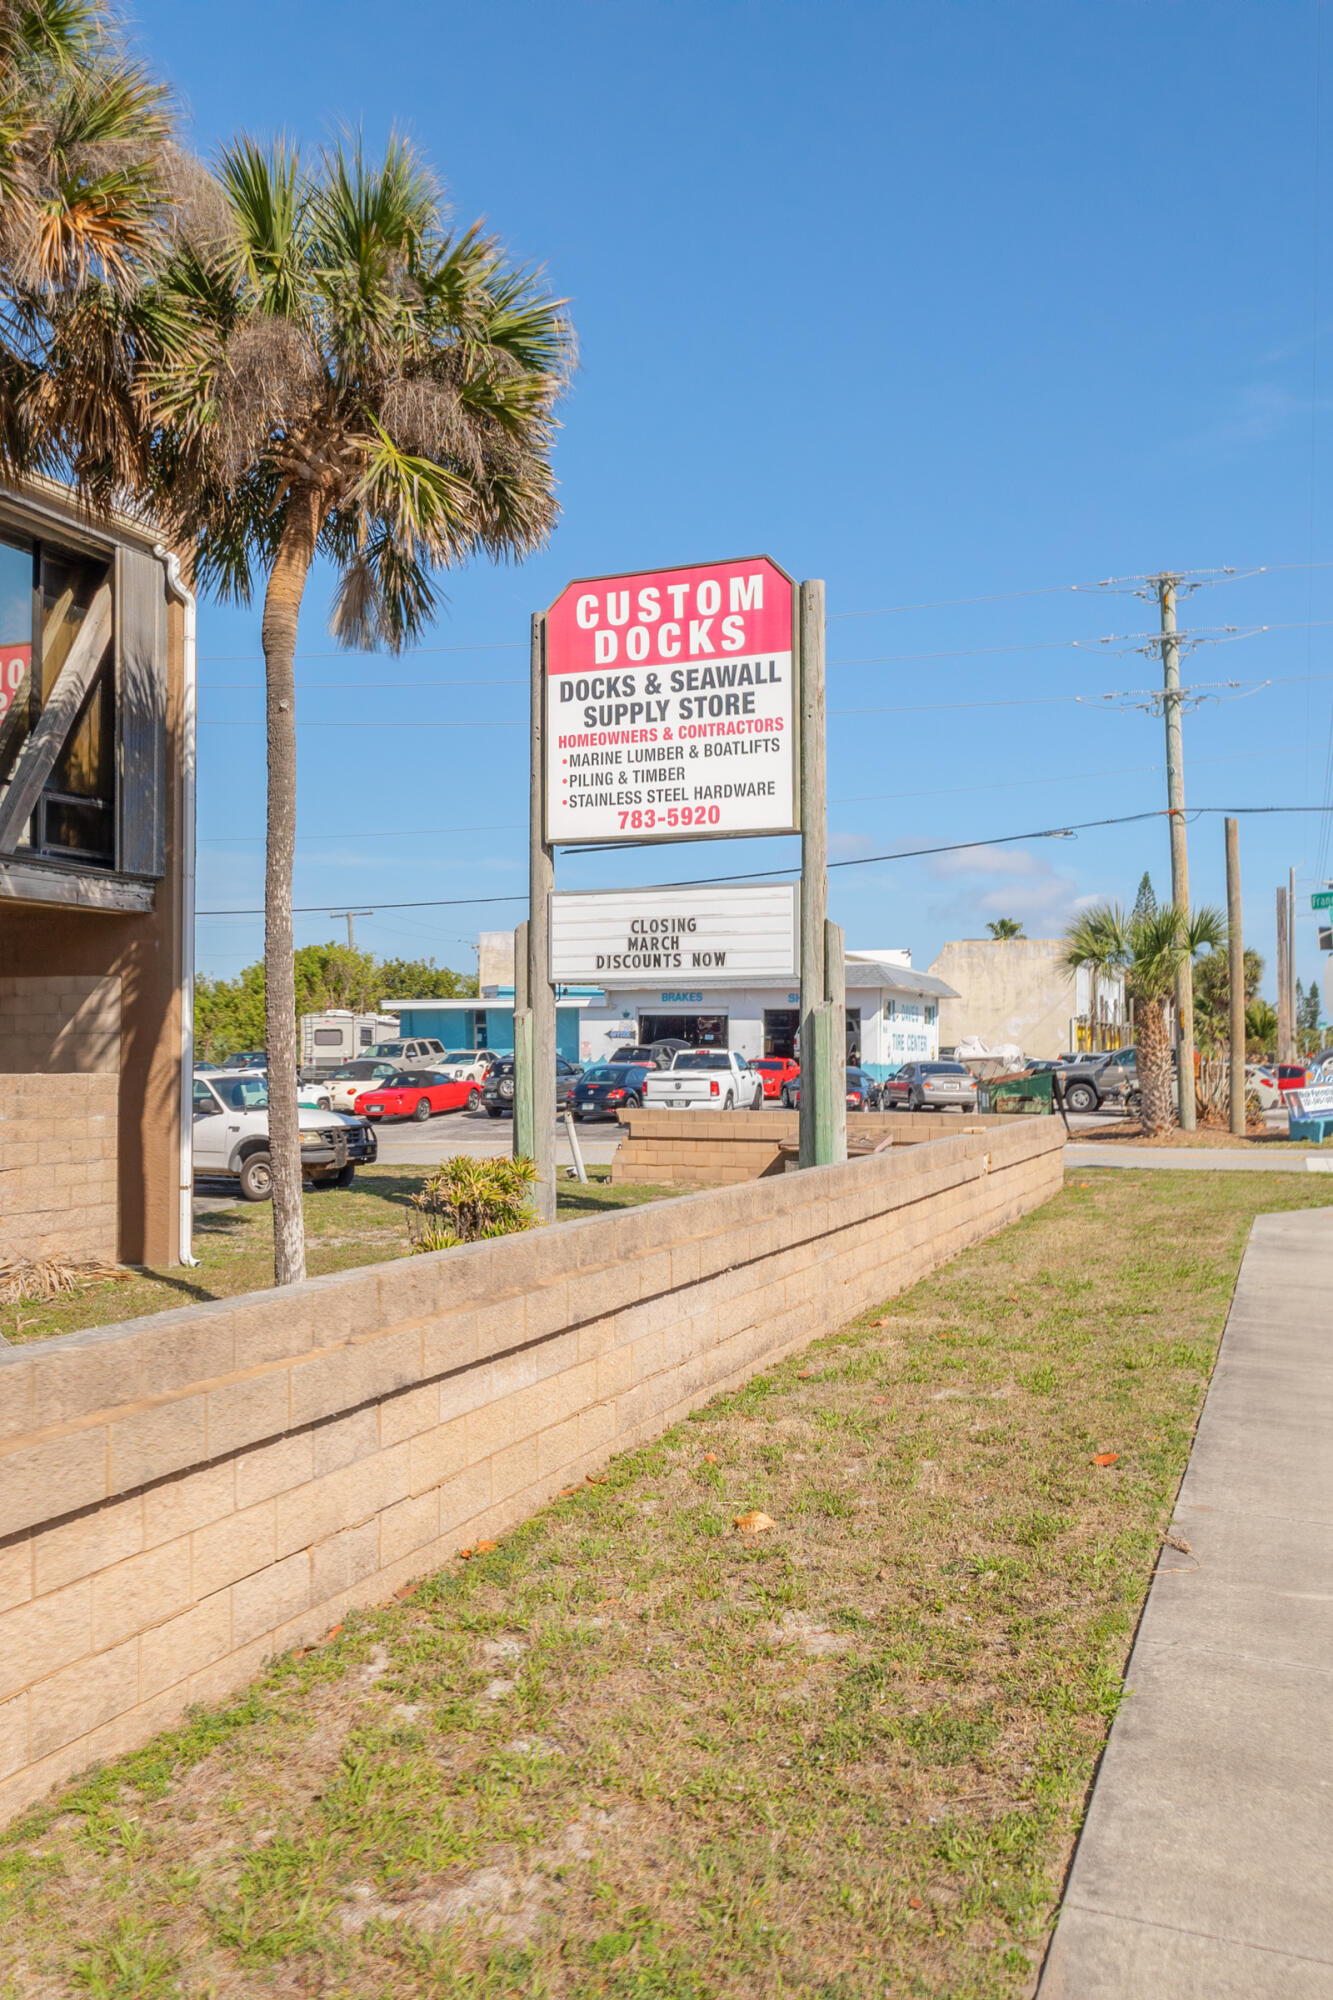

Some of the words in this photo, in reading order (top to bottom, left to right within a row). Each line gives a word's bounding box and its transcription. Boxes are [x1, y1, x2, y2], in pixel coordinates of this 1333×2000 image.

[576, 573, 764, 629] CUSTOM
[594, 614, 746, 664] DOCKS
[559, 674, 636, 703] DOCKS
[645, 672, 662, 695] &
[670, 660, 782, 693] SEAWALL
[583, 698, 670, 728] SUPPLY
[679, 691, 756, 720] STORE
[558, 728, 658, 749] HOMEOWNERS
[663, 726, 673, 741] &
[678, 716, 784, 739] CONTRACTORS
[569, 750, 623, 768] MARINE
[627, 746, 684, 764] LUMBER
[689, 744, 699, 759] &
[704, 737, 781, 758] BOATLIFTS
[569, 771, 614, 788] PILING
[618, 770, 628, 785] &
[633, 766, 686, 784] TIMBER
[569, 790, 642, 809] STAINLESS
[647, 785, 689, 804] STEEL
[694, 780, 776, 801] HARDWARE
[617, 805, 721, 830] 783-5920
[631, 918, 697, 934] CLOSING
[627, 936, 680, 951] MARCH
[596, 953, 682, 969] DISCOUNTS
[692, 952, 727, 967] NOW
[661, 992, 703, 1003] BRAKES
[892, 1033, 905, 1051] TIRE
[907, 1033, 927, 1053] CENTER
